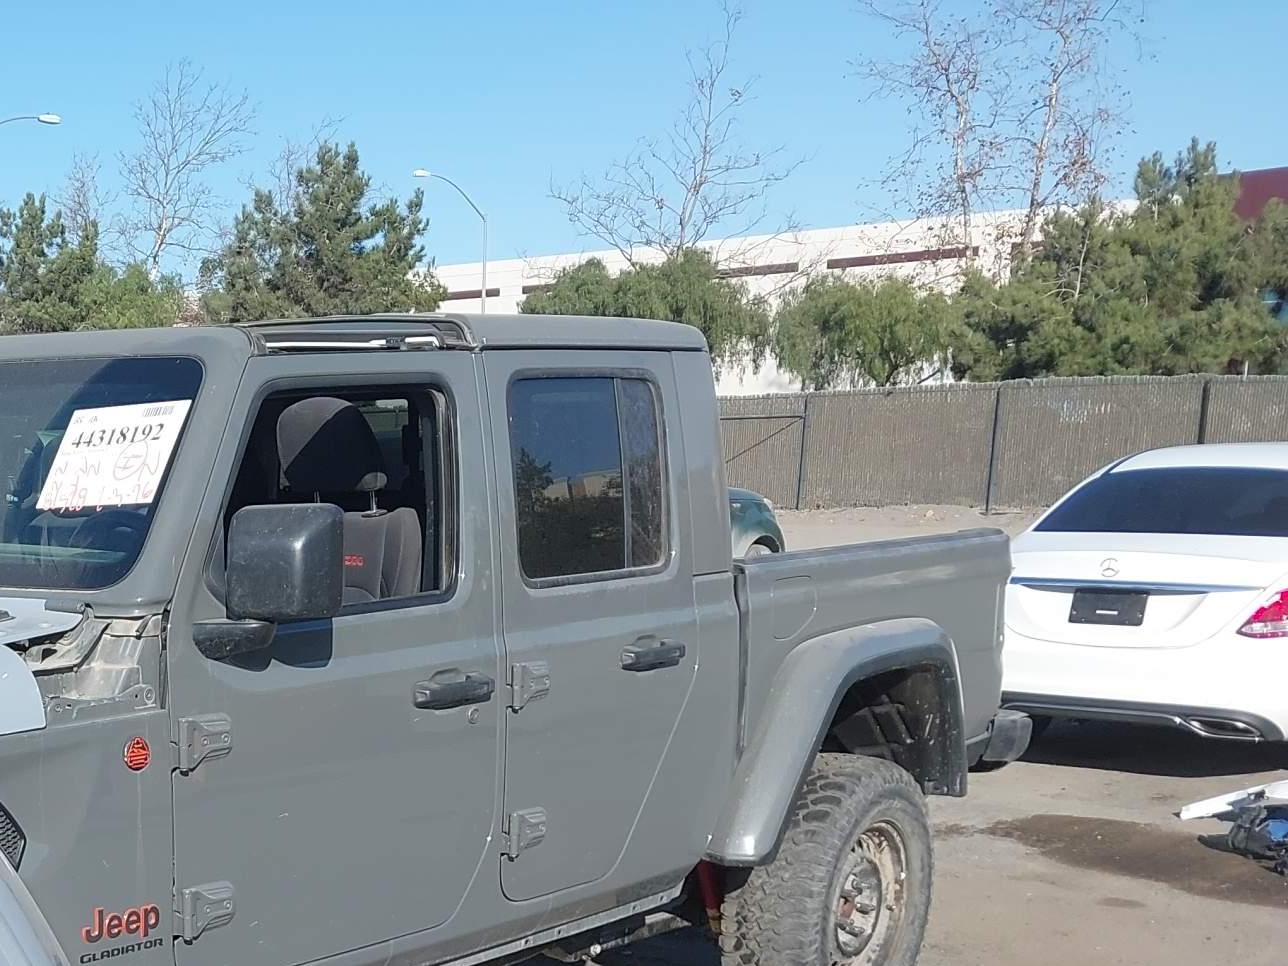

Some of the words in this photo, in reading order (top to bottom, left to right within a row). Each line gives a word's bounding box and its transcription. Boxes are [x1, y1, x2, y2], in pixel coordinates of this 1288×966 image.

[71, 423, 165, 449] 44318192
[81, 903, 160, 943] Jeep
[79, 938, 164, 964] GLADIATOR
